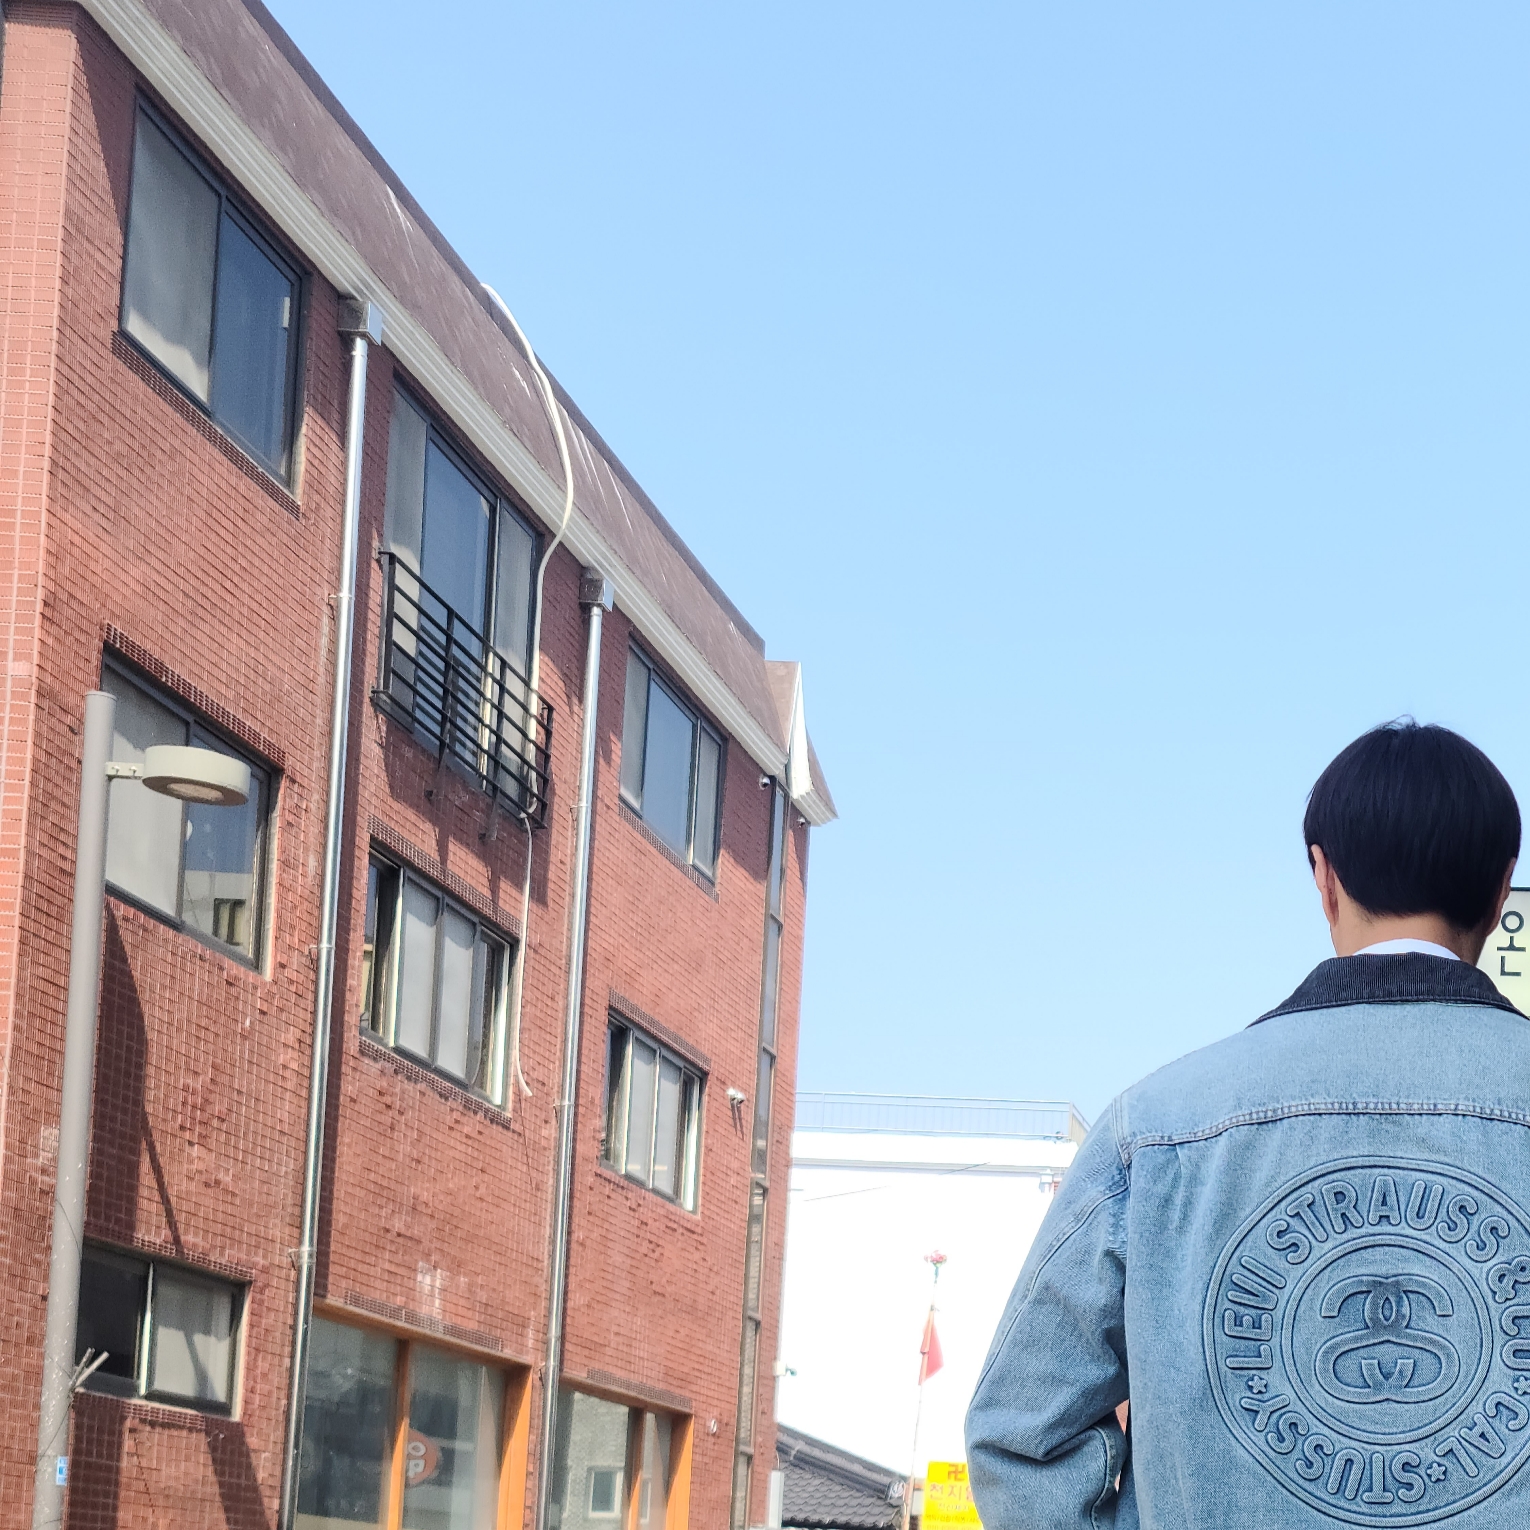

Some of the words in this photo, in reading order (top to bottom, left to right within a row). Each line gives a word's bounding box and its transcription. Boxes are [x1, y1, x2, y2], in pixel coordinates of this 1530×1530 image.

[1224, 1256, 1287, 1370] LEVI
[1266, 1175, 1510, 1264] STRAUSS
[1241, 1394, 1427, 1504] STUSSY
[1437, 1392, 1530, 1477] CAL
